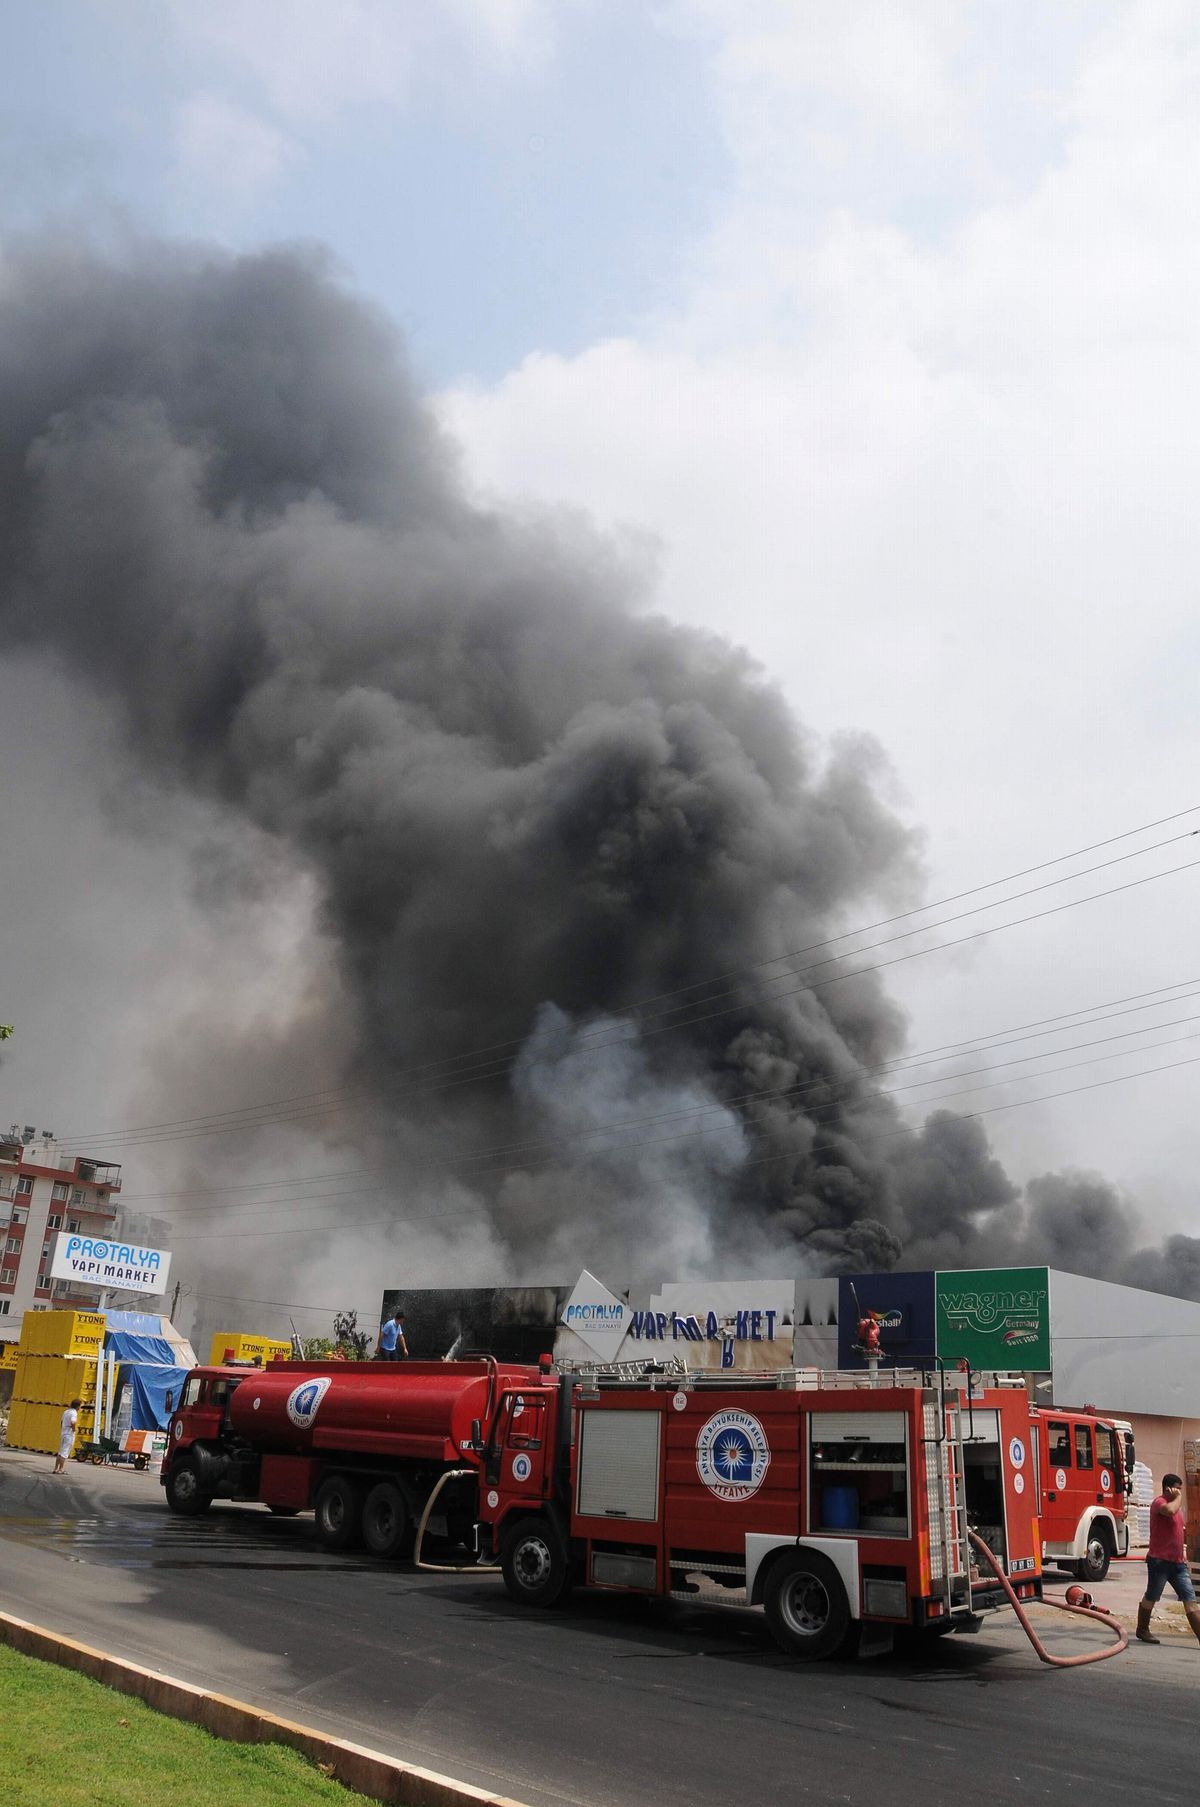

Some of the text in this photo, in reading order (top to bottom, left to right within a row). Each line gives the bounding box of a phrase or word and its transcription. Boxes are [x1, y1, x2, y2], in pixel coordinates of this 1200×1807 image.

[65, 1237, 160, 1270] PROTALYA
[72, 1259, 157, 1283] YAPI MARKET
[938, 1290, 1047, 1321] wagner
[566, 1304, 624, 1323] PROTALYA
[78, 1314, 105, 1325] YTONG
[1005, 1319, 1040, 1330] Germany
[74, 1335, 102, 1345] YTONG
[241, 1343, 265, 1353] YTONG
[268, 1346, 291, 1355] YTONG
